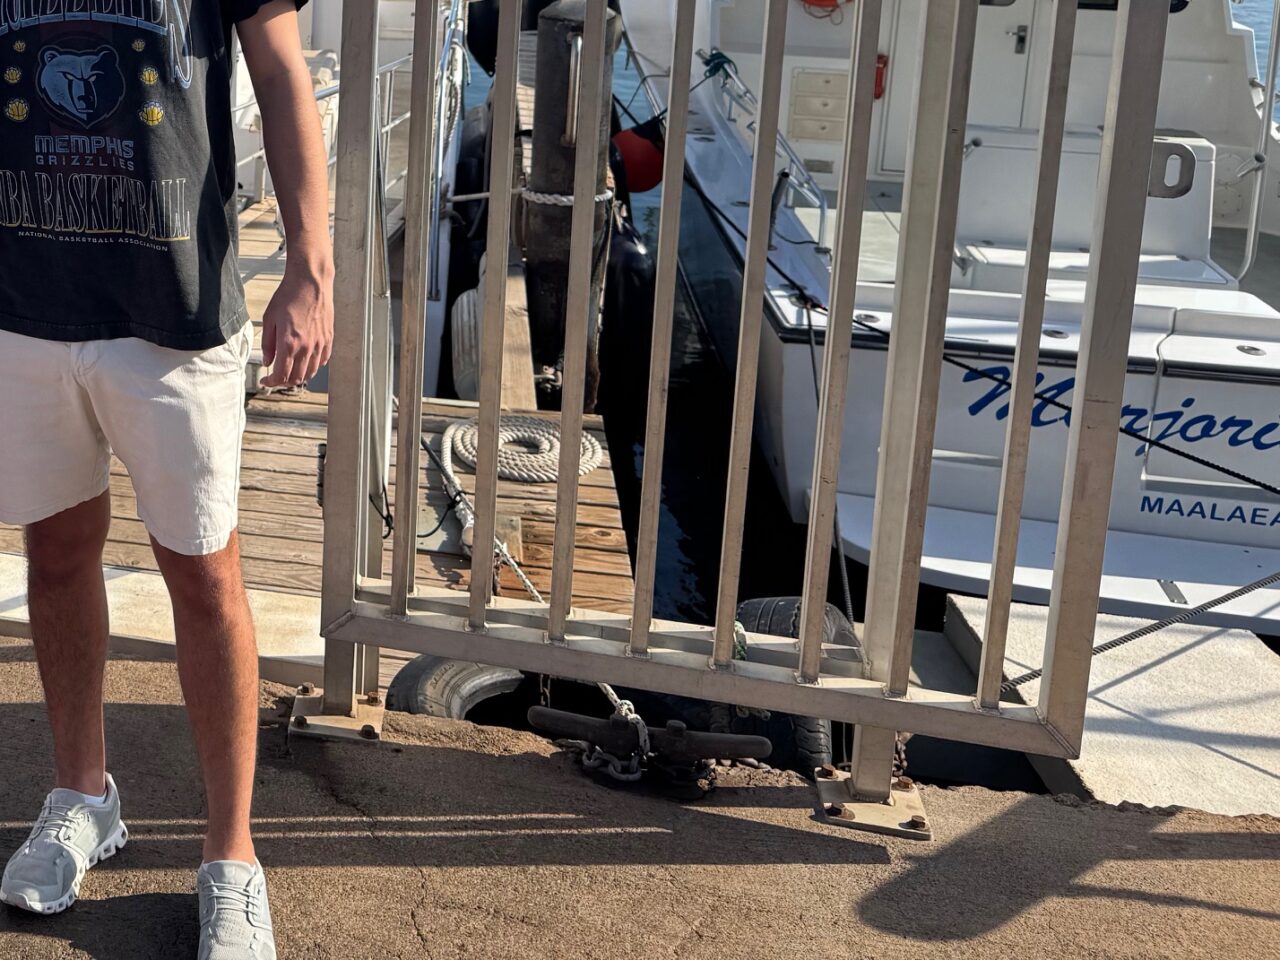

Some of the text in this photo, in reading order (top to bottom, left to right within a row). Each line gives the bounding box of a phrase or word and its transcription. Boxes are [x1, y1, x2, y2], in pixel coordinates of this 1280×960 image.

[34, 134, 134, 158] MEMPHIS
[35, 154, 135, 172] GRIZZLIES
[34, 171, 190, 241] BASKETBALL
[18, 230, 168, 252] NATIONAL BASKETBALL ASSOCIATION
